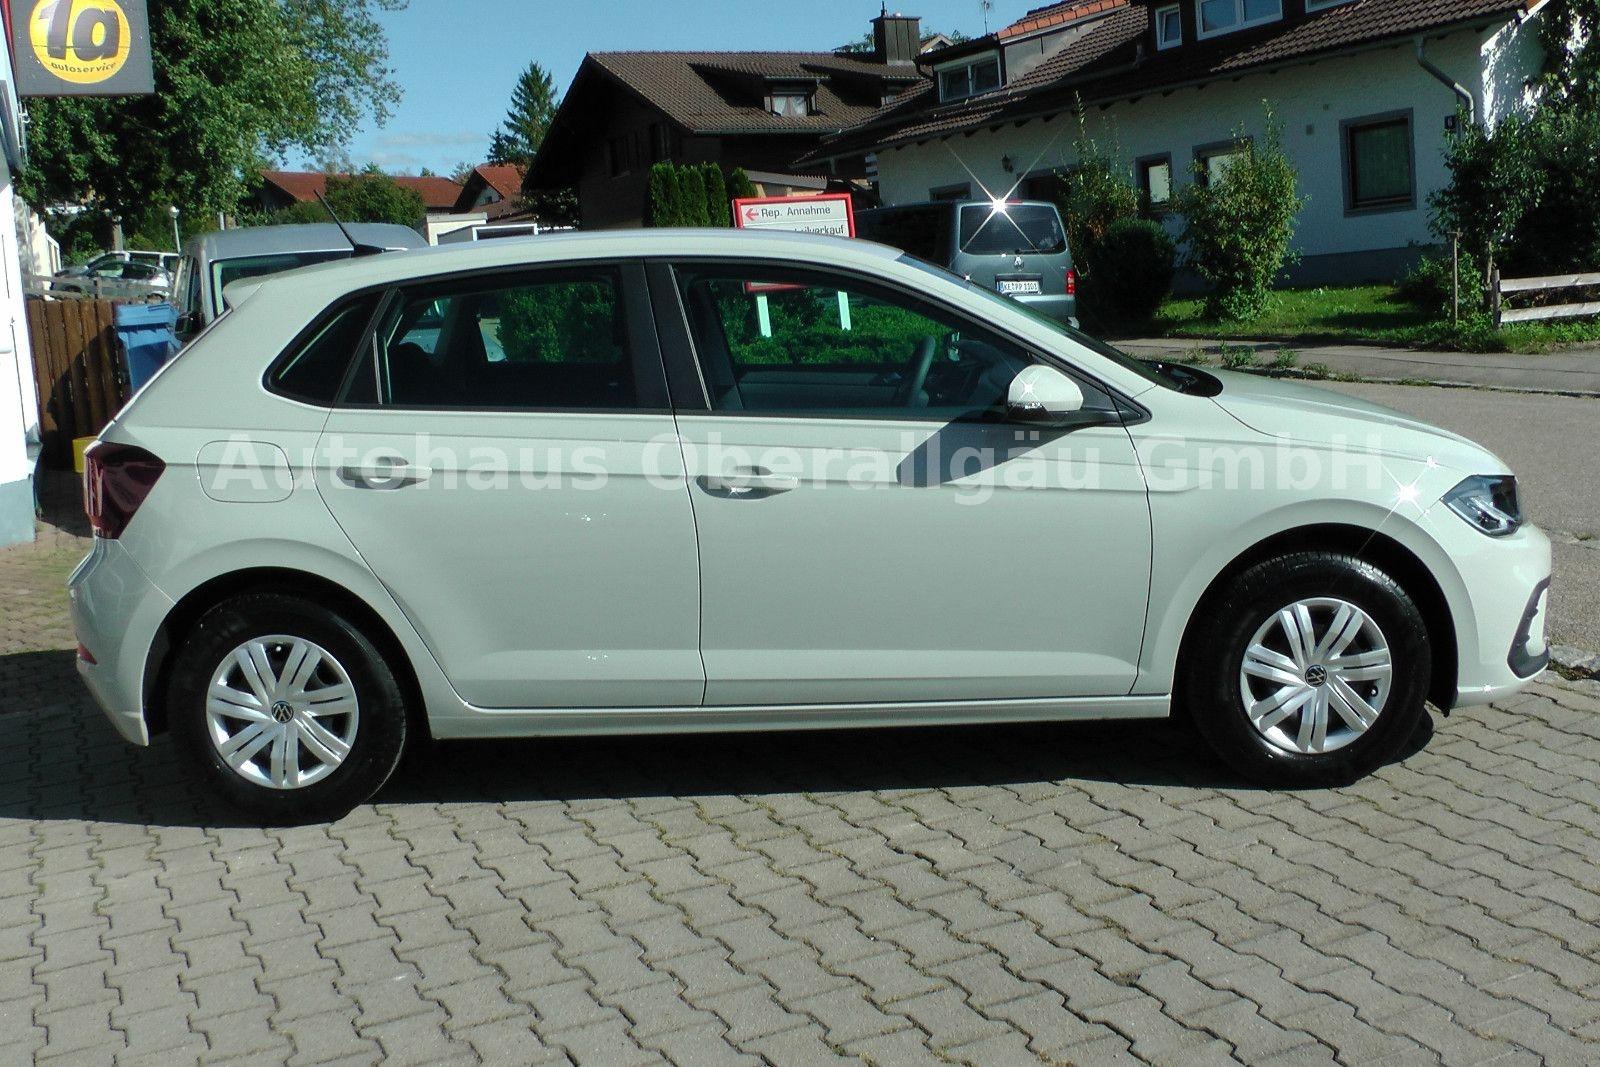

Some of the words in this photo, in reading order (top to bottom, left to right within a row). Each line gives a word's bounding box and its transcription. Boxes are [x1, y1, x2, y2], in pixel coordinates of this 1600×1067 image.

[50, 62, 117, 73] autoservice
[761, 208, 783, 219] Rep.
[787, 205, 831, 216] Annahme
